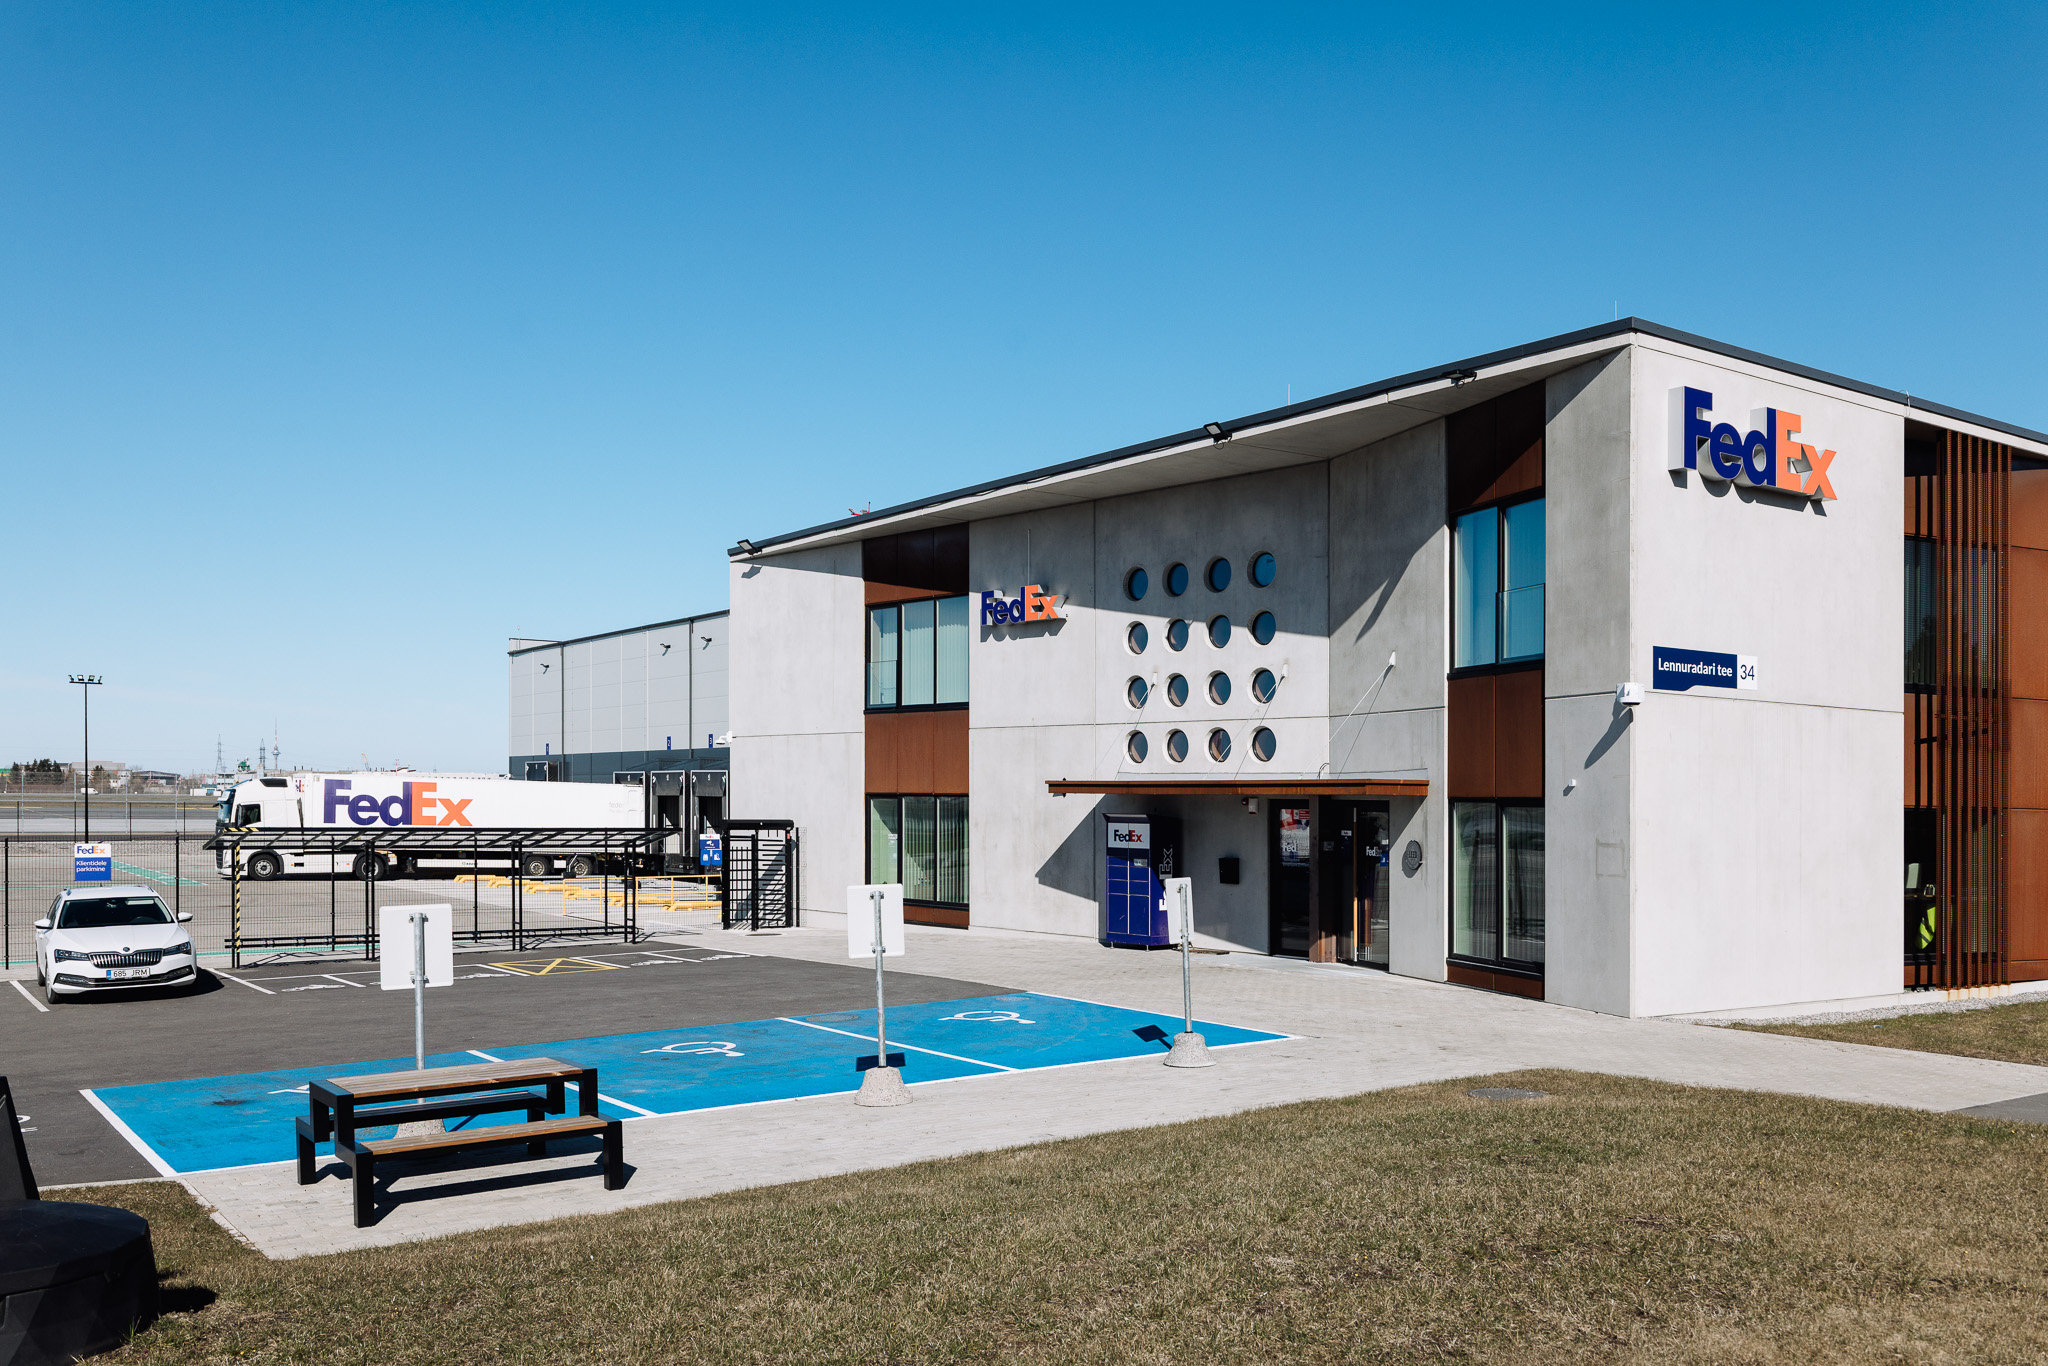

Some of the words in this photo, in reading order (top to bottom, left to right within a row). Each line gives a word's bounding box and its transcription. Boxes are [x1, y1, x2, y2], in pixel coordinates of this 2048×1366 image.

[1684, 386, 1838, 500] FedEx
[981, 584, 1059, 626] FedEx
[1658, 657, 1716, 676] Lennuradari
[1717, 664, 1733, 677] tee
[1740, 664, 1755, 681] 34
[324, 779, 473, 826] FedEx
[1114, 829, 1143, 843] FedEx
[77, 845, 105, 855] FedEx
[113, 970, 127, 978] 685
[131, 969, 148, 977] JRM
